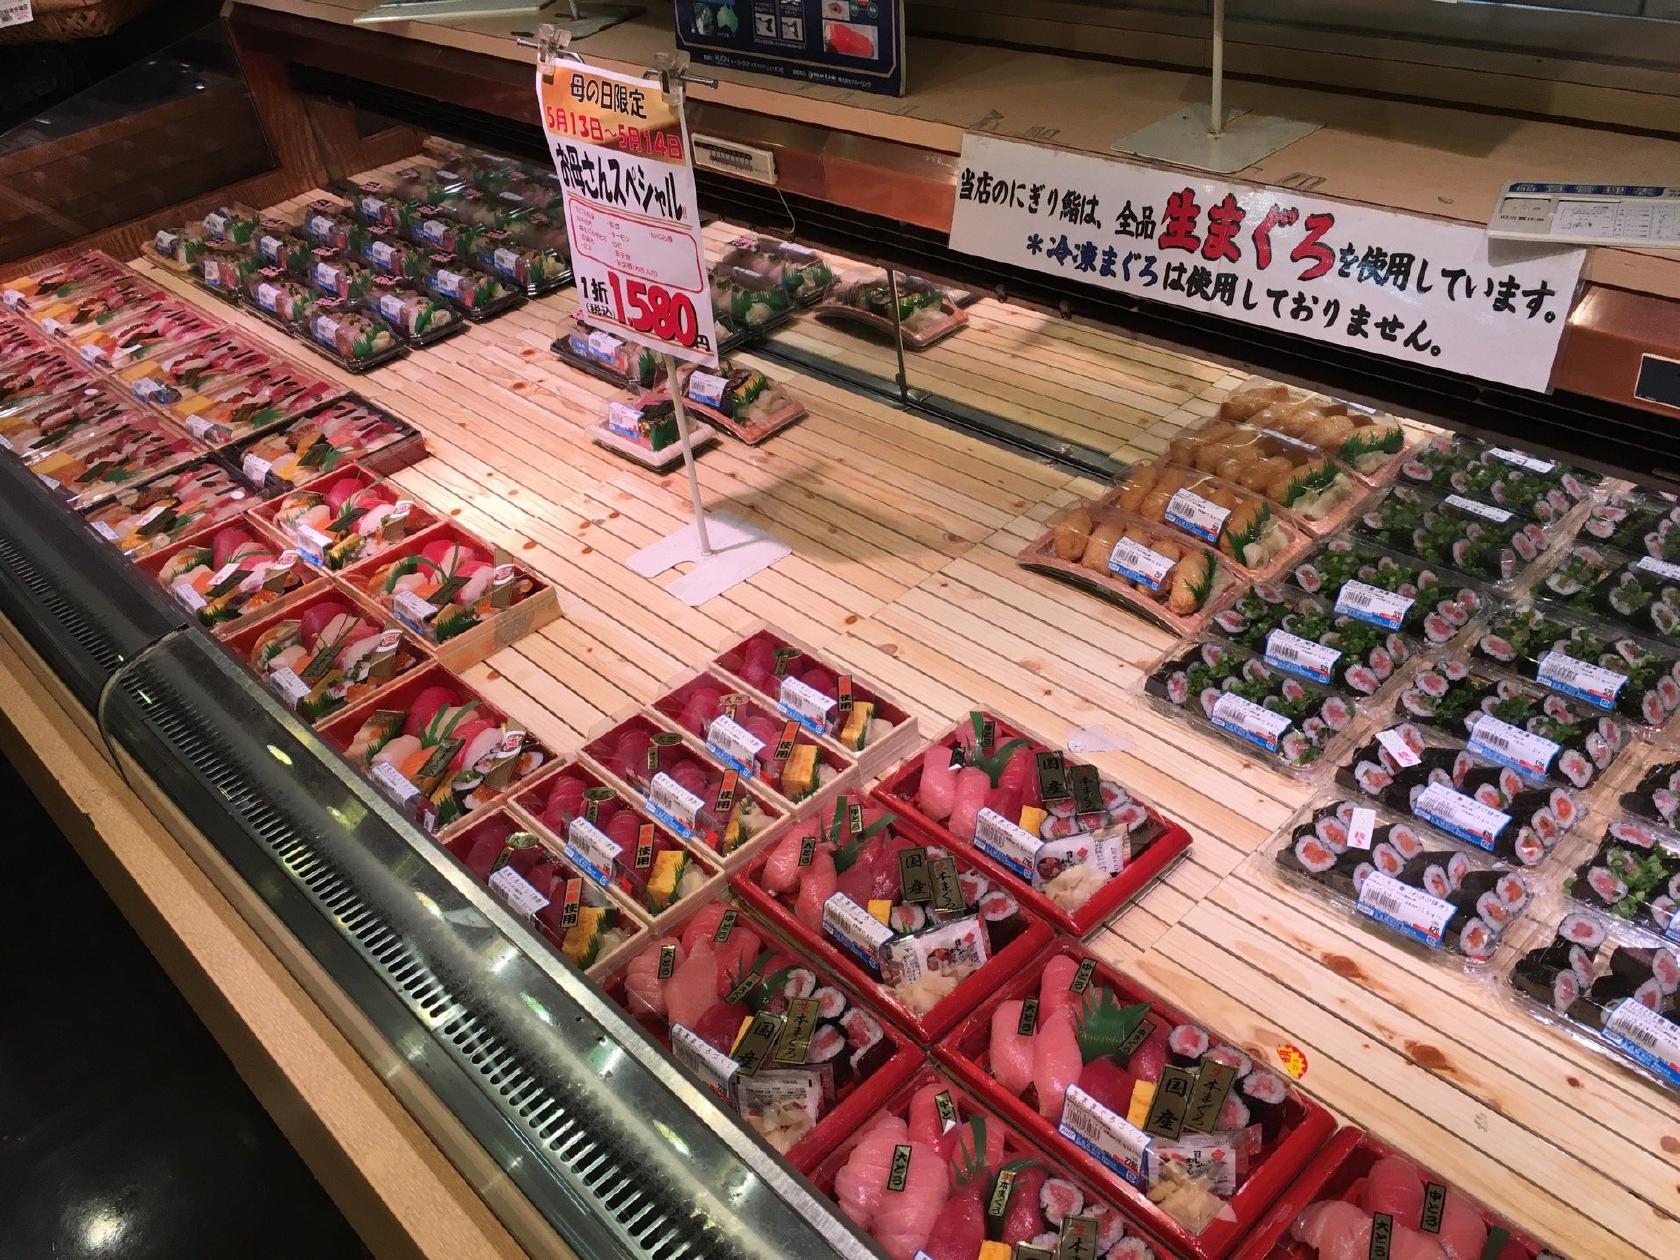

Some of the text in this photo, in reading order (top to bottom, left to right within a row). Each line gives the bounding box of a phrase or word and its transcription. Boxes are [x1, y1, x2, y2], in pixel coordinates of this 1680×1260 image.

[571, 73, 647, 120] 母の日限定
[580, 275, 609, 305] 1折
[585, 302, 617, 320] (税込)
[904, 852, 928, 896] 国産
[1073, 961, 1093, 990] 中とろ
[1021, 1002, 1035, 1033] 大とろ
[737, 1020, 775, 1071] 国産
[1152, 1076, 1188, 1132] 国産
[891, 1150, 908, 1188] 大とろ
